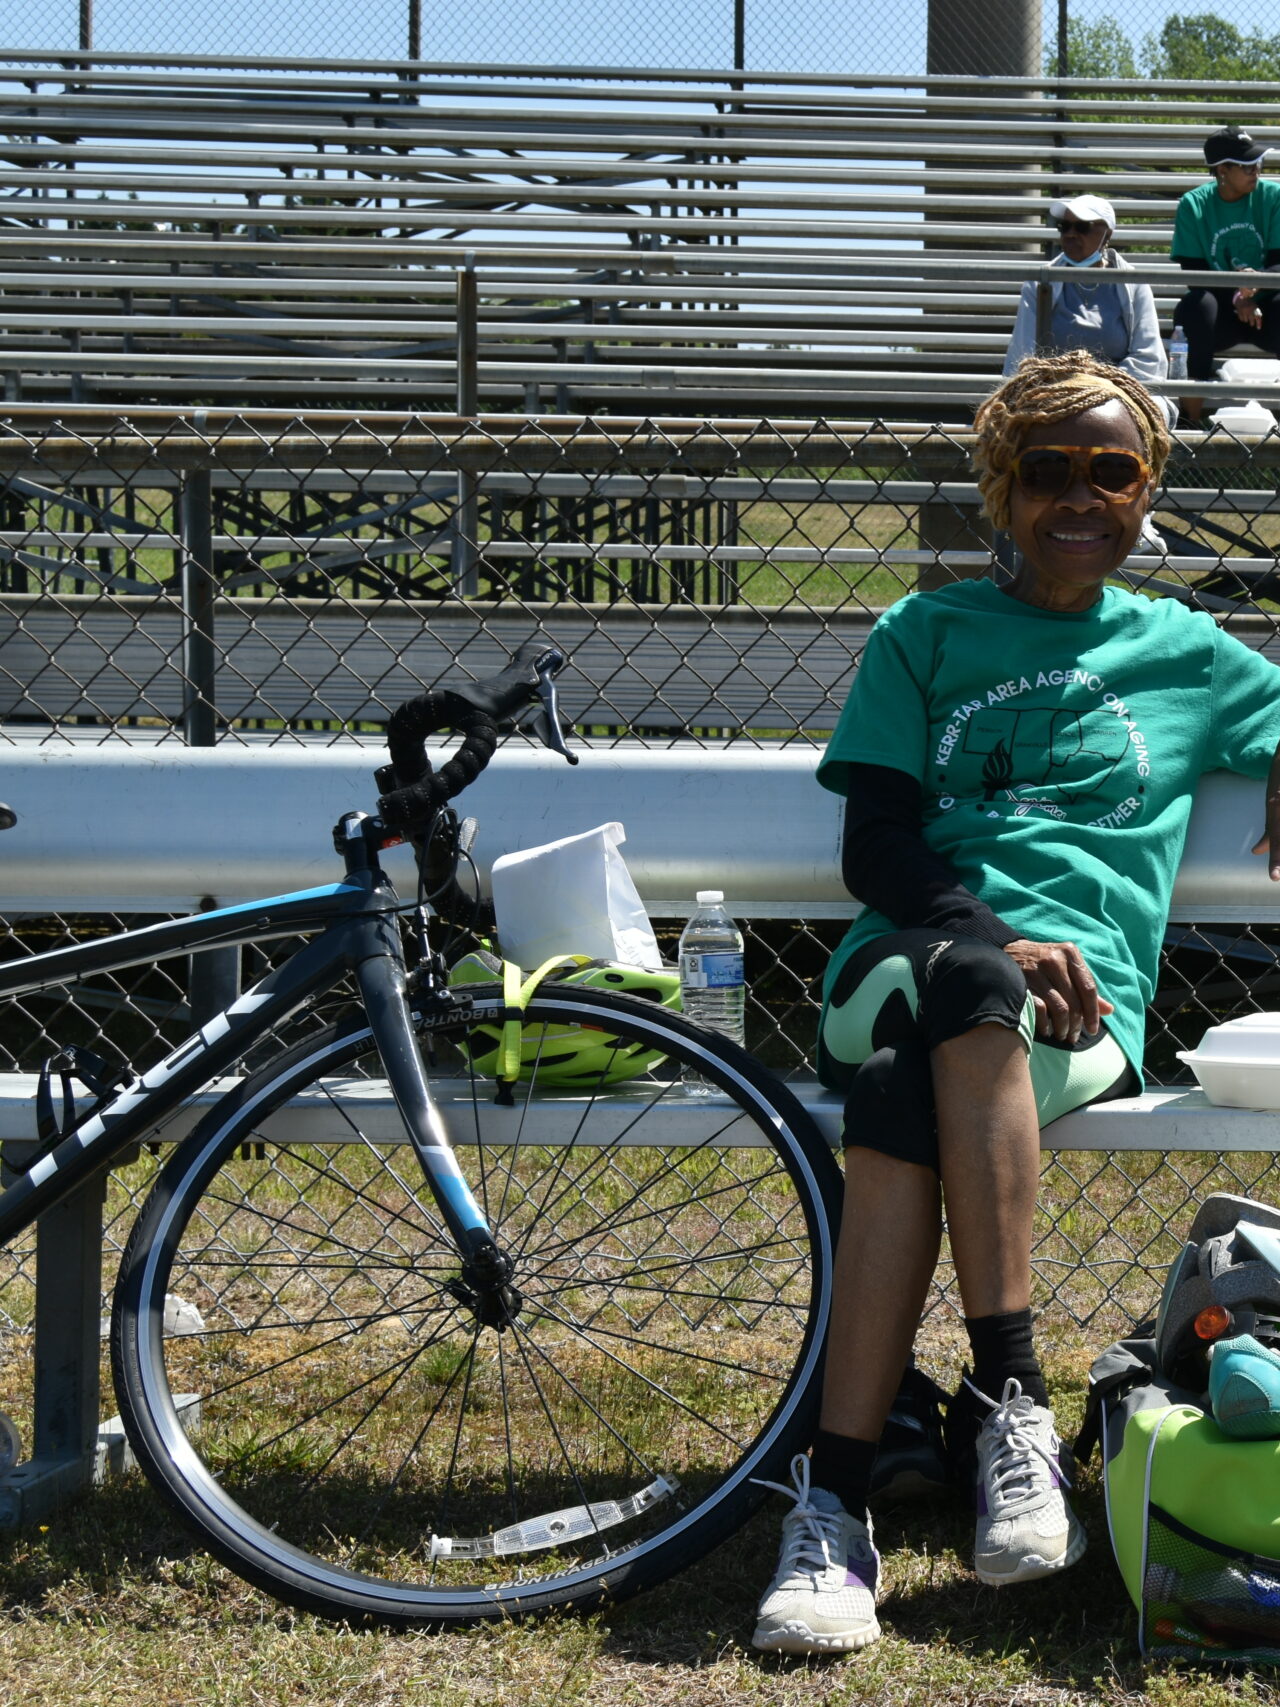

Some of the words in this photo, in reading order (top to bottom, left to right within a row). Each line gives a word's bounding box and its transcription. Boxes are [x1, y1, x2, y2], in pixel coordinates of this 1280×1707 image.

[935, 699, 984, 767] KERR-TAR
[986, 676, 1032, 706] AREA
[1102, 692, 1129, 718] ON
[1121, 719, 1150, 778] AGING
[500, 1550, 618, 1590] BONTRAGER
